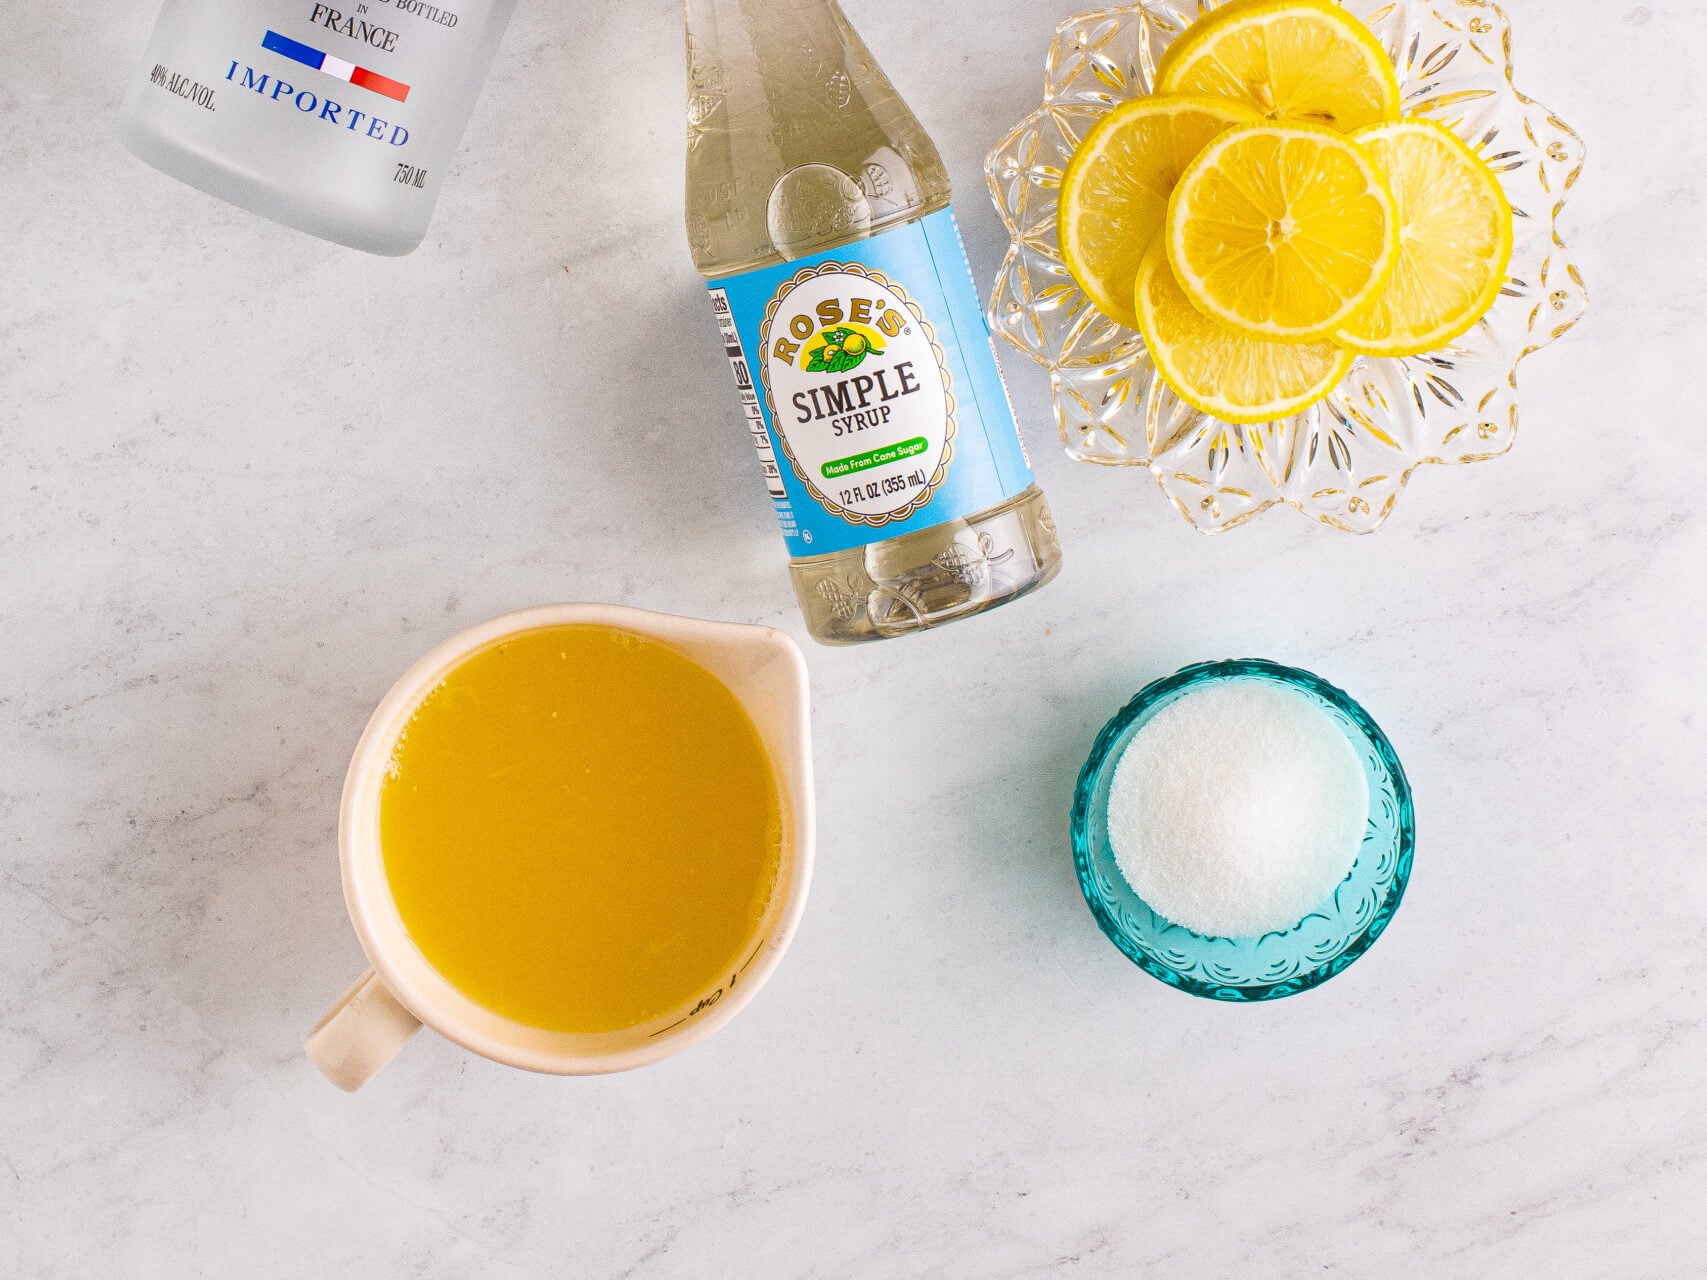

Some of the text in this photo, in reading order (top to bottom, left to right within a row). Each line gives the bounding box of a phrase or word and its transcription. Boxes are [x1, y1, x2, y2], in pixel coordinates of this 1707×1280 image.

[357, 3, 369, 15] IN
[309, 3, 399, 53] FRANCE
[150, 63, 167, 83] 40%
[225, 60, 410, 147] IMPORTED
[393, 162, 428, 190] 750 ML
[711, 294, 728, 312] acts
[773, 297, 906, 366] ROSE'S
[733, 360, 750, 385] 80
[791, 360, 921, 424] SIMPLE
[831, 405, 891, 437] SYRUP
[825, 441, 924, 476] Made From Cane Sugar
[839, 469, 926, 505] 12 FL OZ (355 mL)
[689, 974, 736, 1016] 1 Cup
